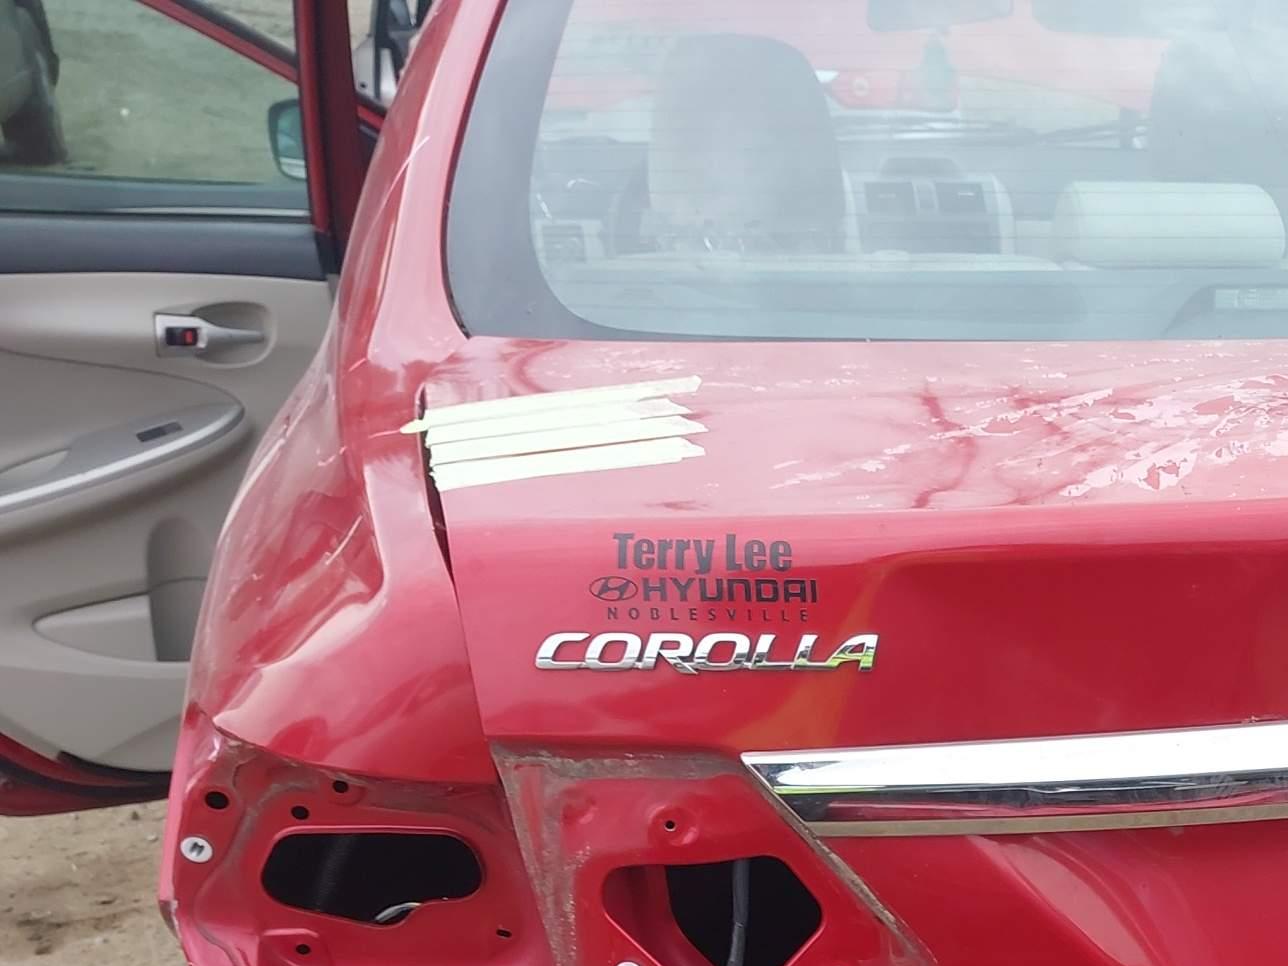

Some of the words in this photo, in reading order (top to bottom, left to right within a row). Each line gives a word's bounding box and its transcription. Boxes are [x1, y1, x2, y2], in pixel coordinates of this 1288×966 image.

[613, 533, 715, 574] Terry
[726, 533, 792, 571] Lee
[643, 577, 818, 603] HYUNDAI
[608, 607, 809, 622] NOBLESVILLE
[535, 631, 880, 675] COROLLA
